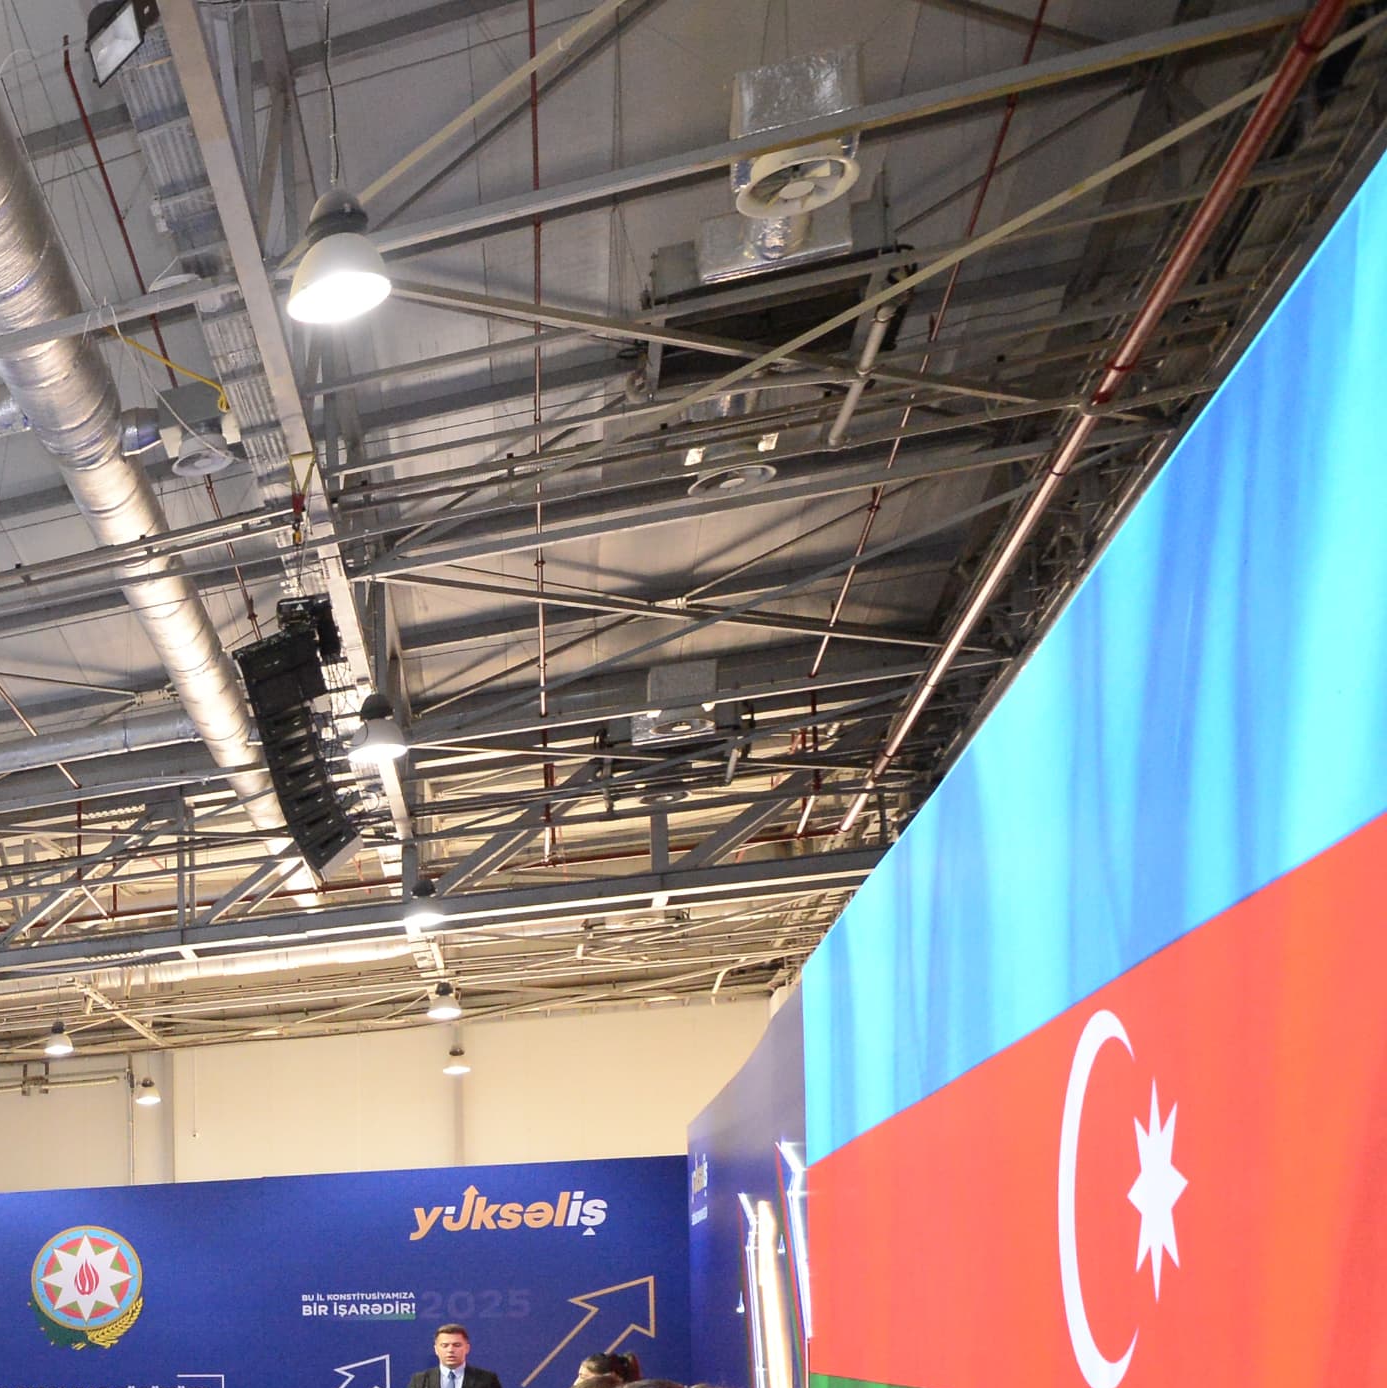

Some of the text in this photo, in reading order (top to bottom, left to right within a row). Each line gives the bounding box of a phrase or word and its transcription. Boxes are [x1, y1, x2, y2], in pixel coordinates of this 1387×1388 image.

[317, 1293, 325, 1301] İL
[327, 1291, 415, 1301] KONSTİTUSİYAMIZA
[302, 1301, 416, 1317] BİR İŞARƏDİR!
[421, 1291, 531, 1319] 2025
